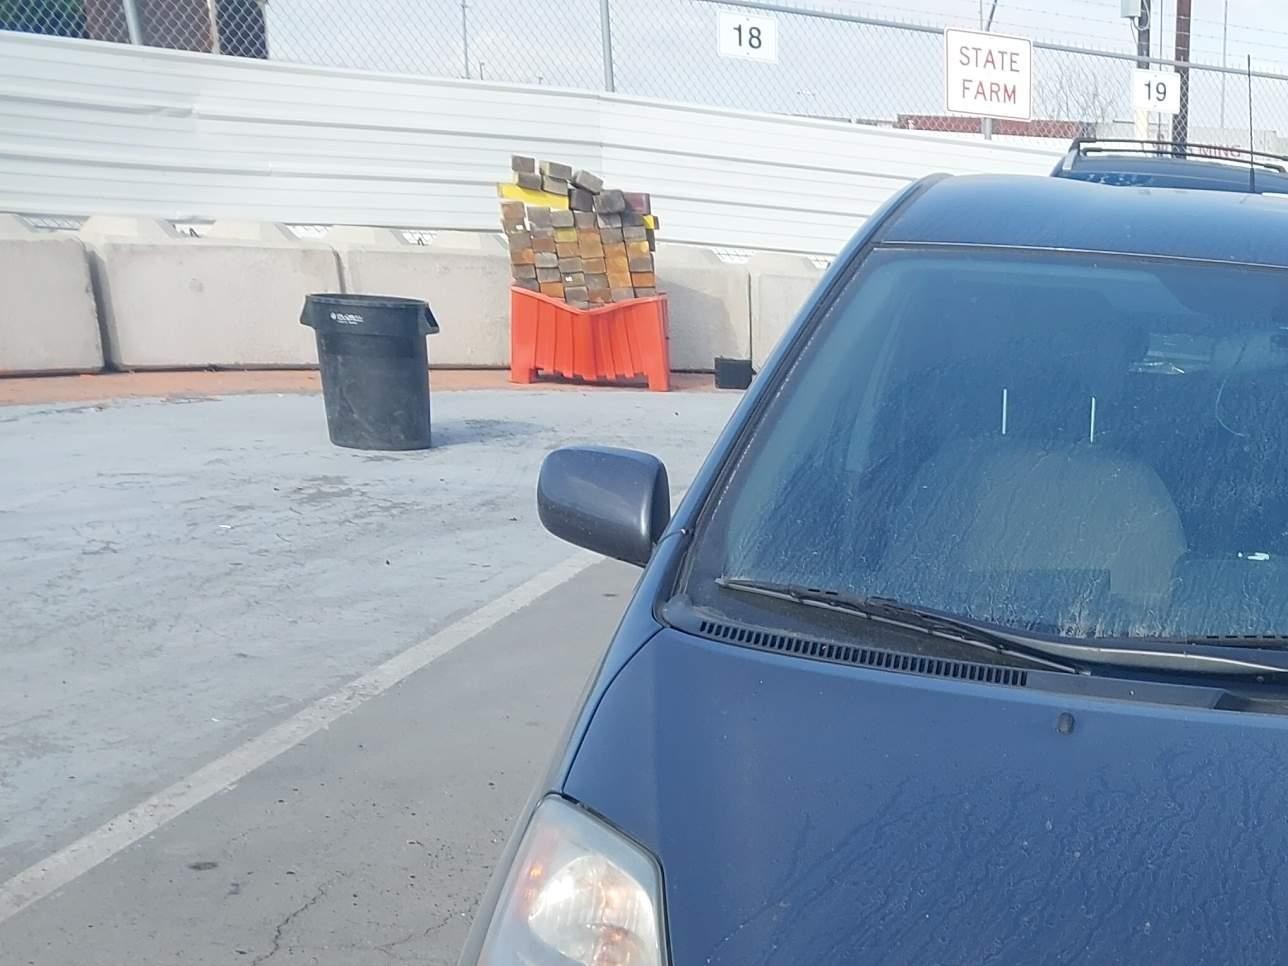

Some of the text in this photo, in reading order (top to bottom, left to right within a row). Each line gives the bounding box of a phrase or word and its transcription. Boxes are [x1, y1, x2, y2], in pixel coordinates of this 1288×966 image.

[733, 24, 762, 49] 18
[959, 46, 1020, 72] STATE
[962, 79, 1016, 104] FARM
[1144, 80, 1167, 102] 19
